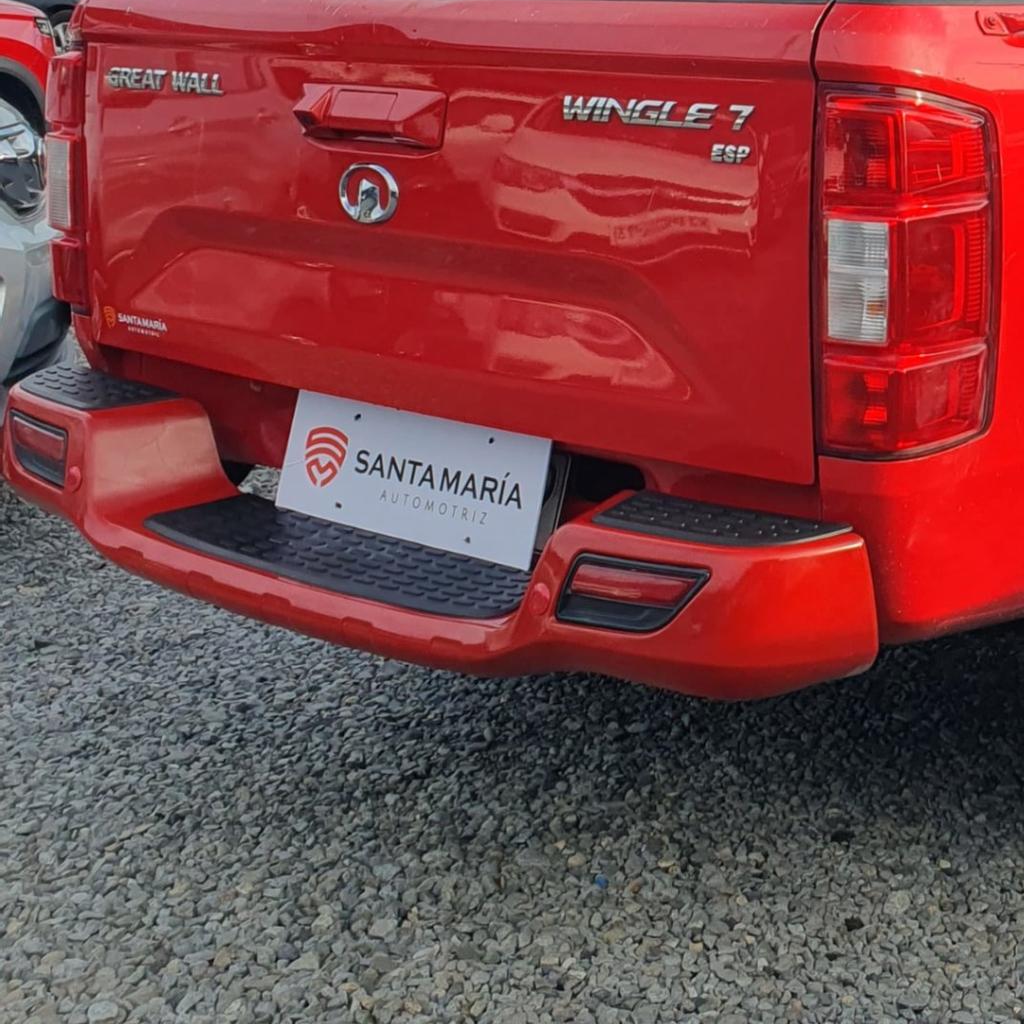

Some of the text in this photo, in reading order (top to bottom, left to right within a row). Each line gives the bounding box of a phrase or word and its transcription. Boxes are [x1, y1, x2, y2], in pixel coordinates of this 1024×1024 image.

[107, 67, 224, 96] GREAT WALL
[563, 95, 755, 132] WINGLE 7
[710, 143, 751, 164] ESP
[354, 449, 523, 510] SANTAMARÍA
[379, 488, 489, 526] AUTOMOTRIZ
